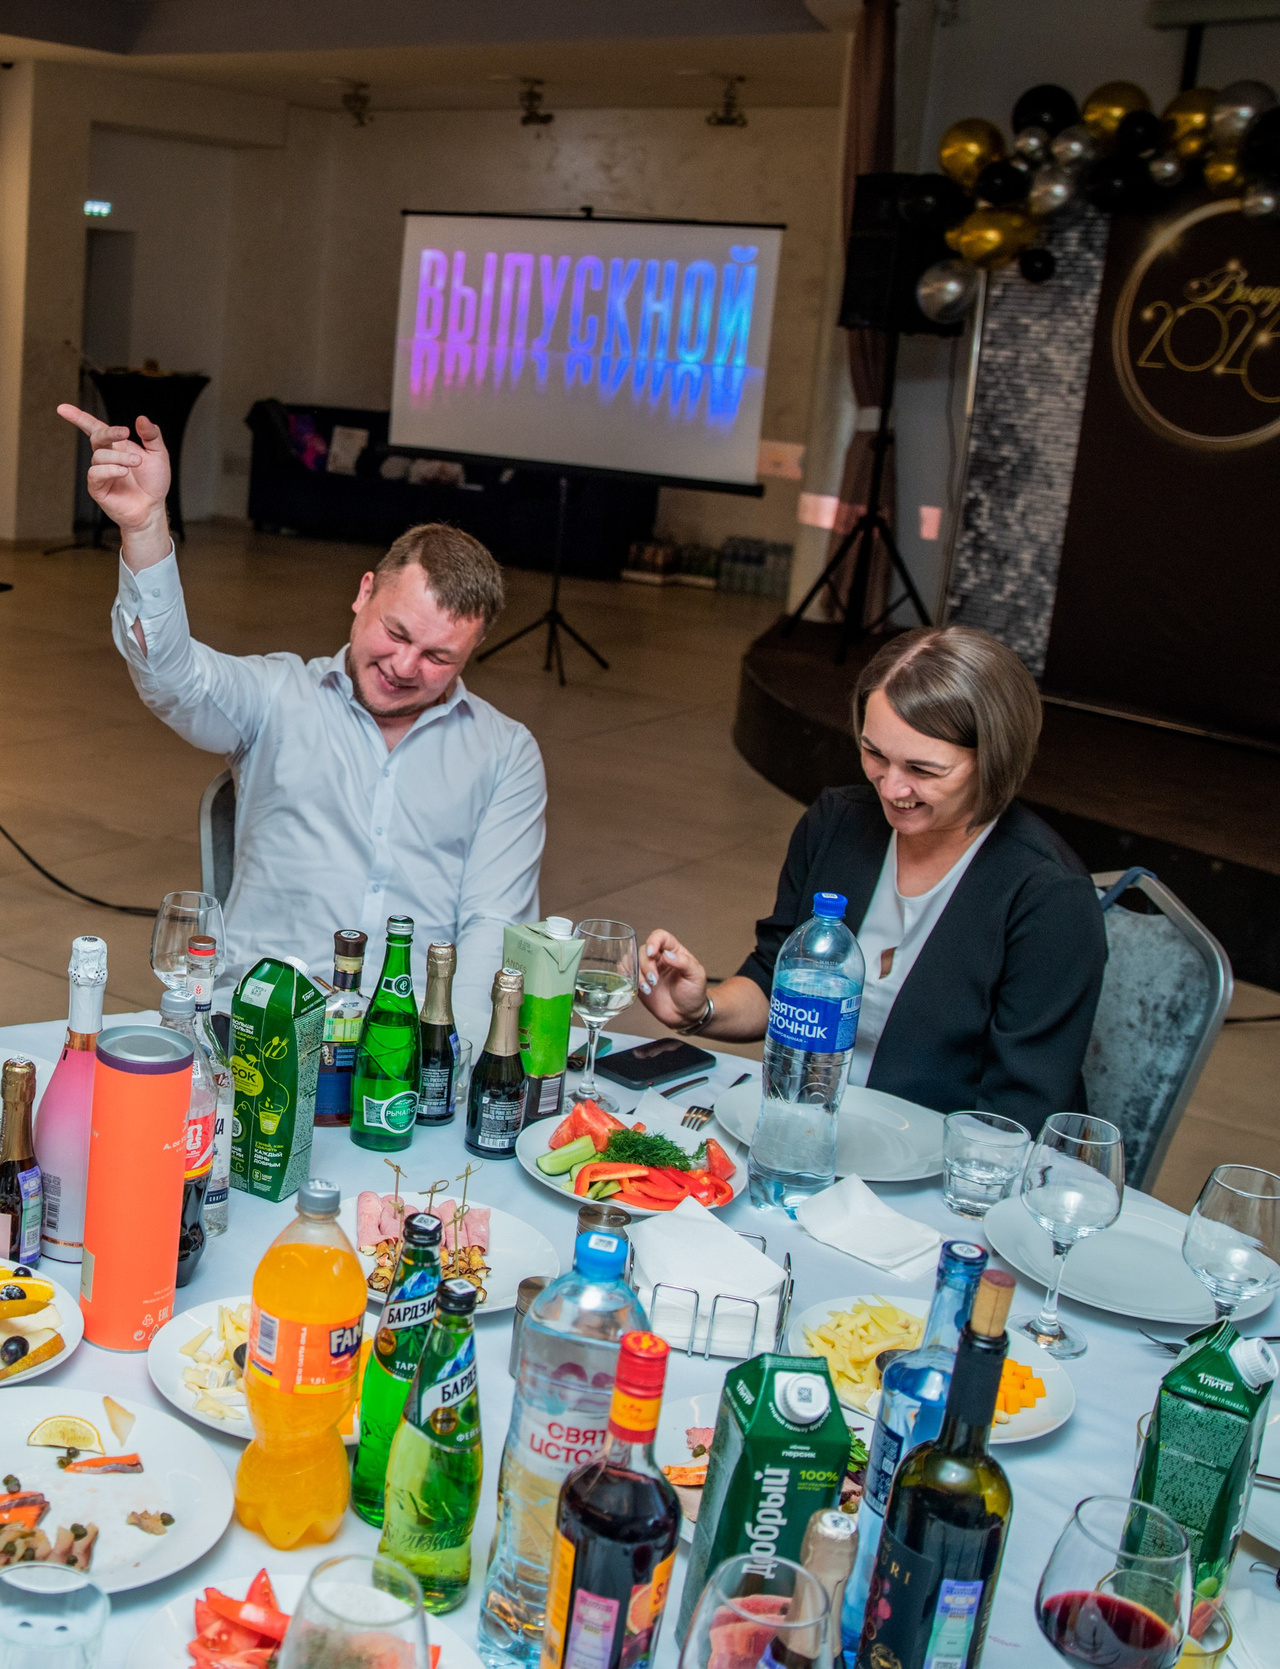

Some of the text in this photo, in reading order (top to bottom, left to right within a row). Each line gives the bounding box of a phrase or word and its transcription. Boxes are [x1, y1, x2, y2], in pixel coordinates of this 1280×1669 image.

[415, 245, 758, 366] ВЫПУСКНОЙ
[769, 1009, 828, 1039] СТОЧНИК
[231, 1065, 256, 1083] СОК
[387, 1297, 436, 1324] БАРДЗИ
[330, 1322, 363, 1355] FAN
[441, 1365, 477, 1403] БАРДЗ
[1204, 1379, 1234, 1392] ЛИТР
[548, 1422, 608, 1447] СВЯТ
[529, 1433, 600, 1466] ИСТО
[781, 1450, 817, 1459] персик
[799, 1470, 838, 1481] 100%
[742, 1467, 791, 1580] Добрый
